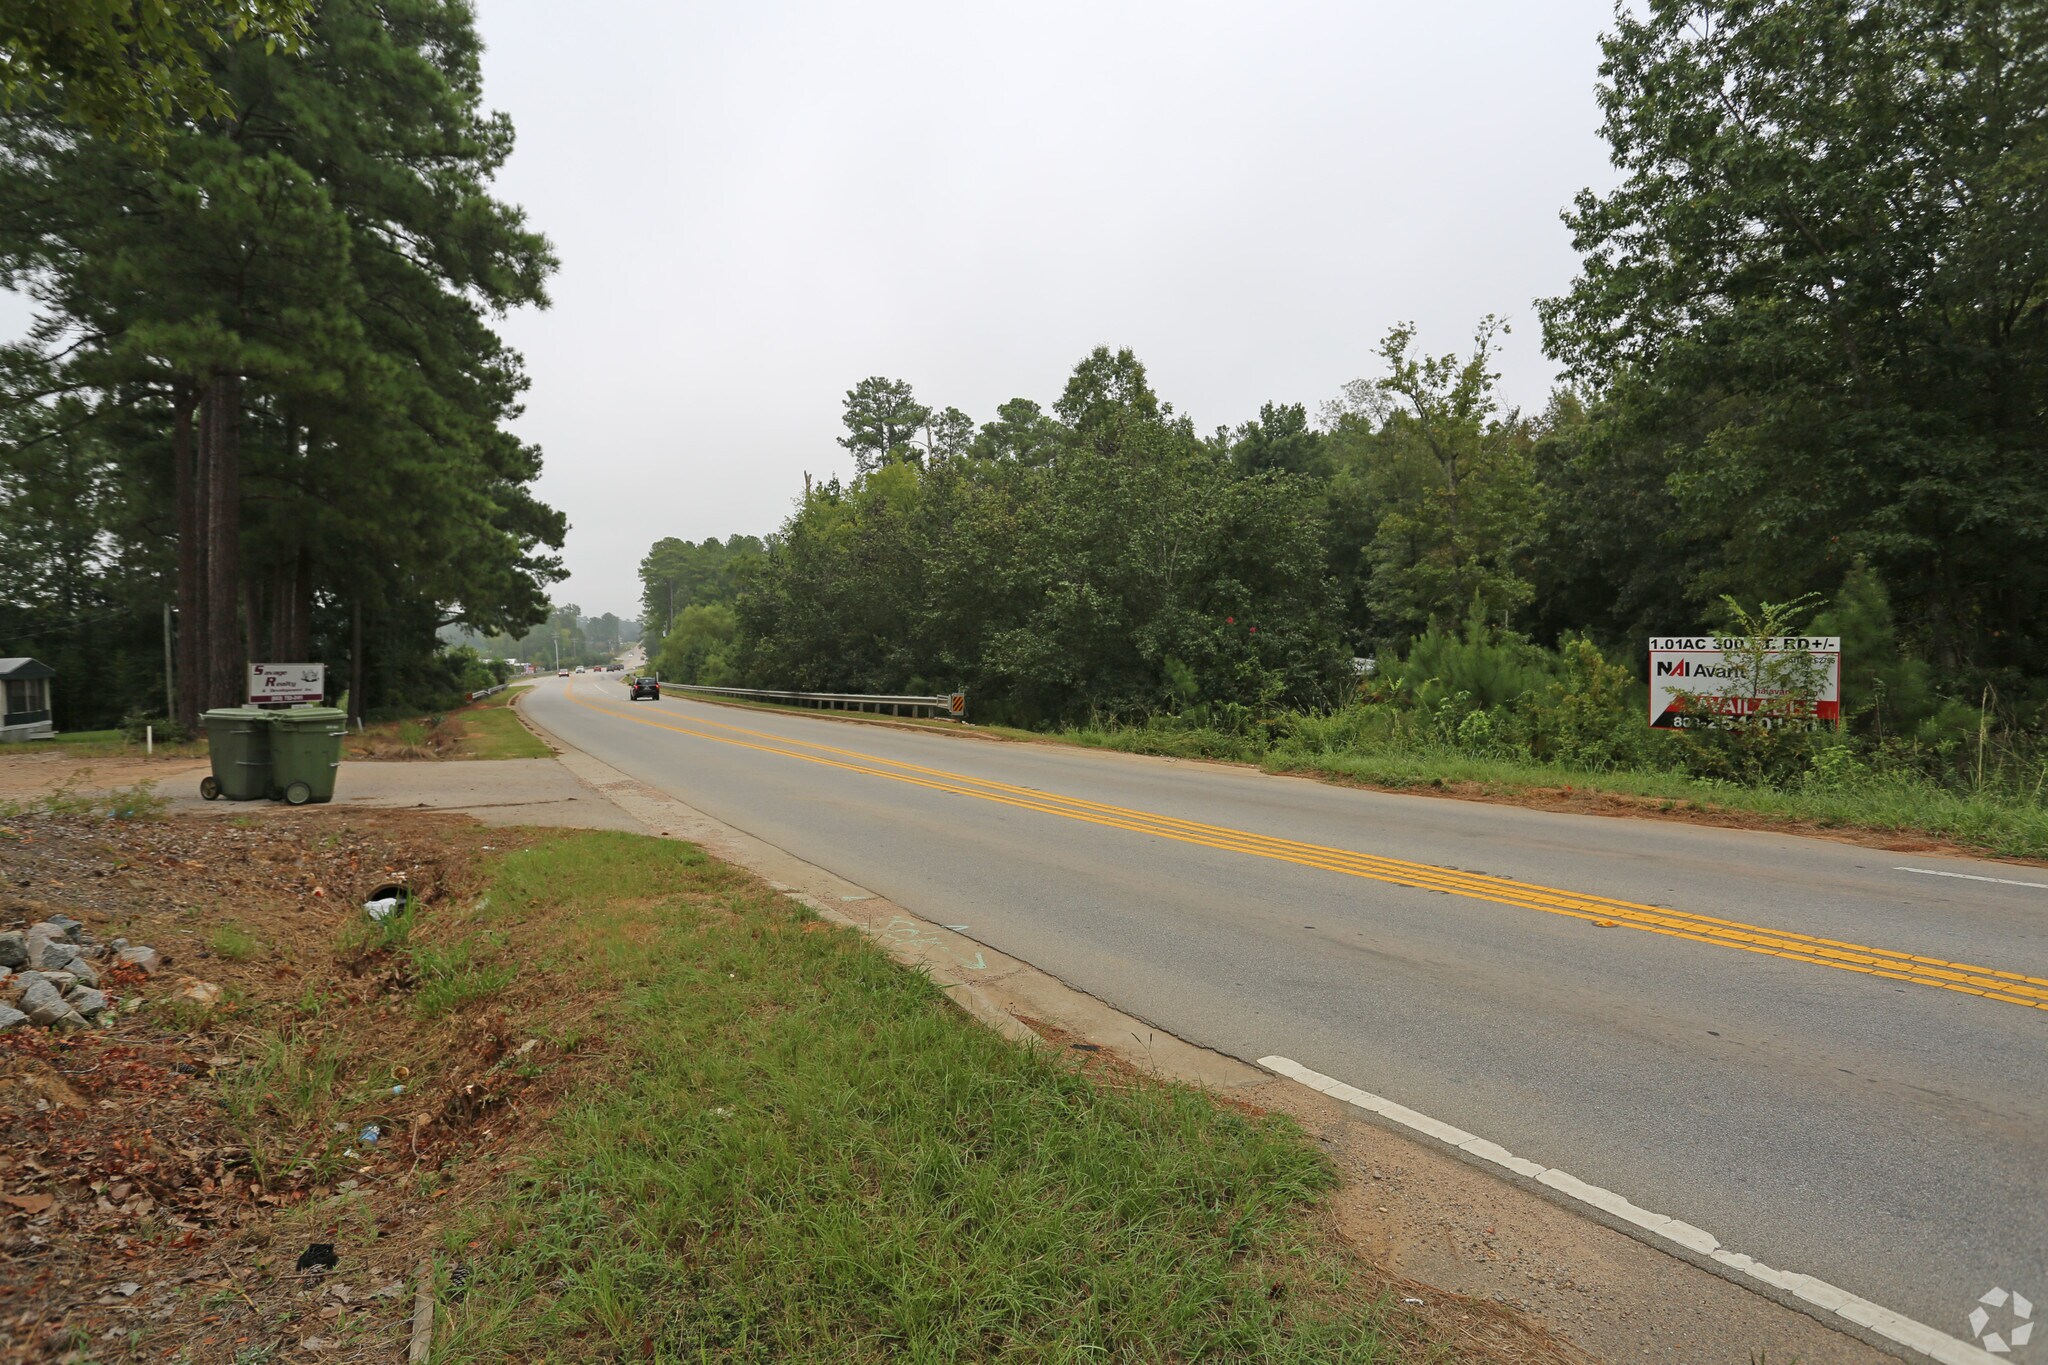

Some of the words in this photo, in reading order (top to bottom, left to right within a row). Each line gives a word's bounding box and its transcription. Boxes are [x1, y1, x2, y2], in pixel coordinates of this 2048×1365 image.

[1650, 639, 1706, 649] 1.01AC
[1713, 639, 1744, 649] 300
[1657, 658, 1690, 676] NAI
[1694, 664, 1746, 678] Avant
[265, 677, 296, 687] Realty
